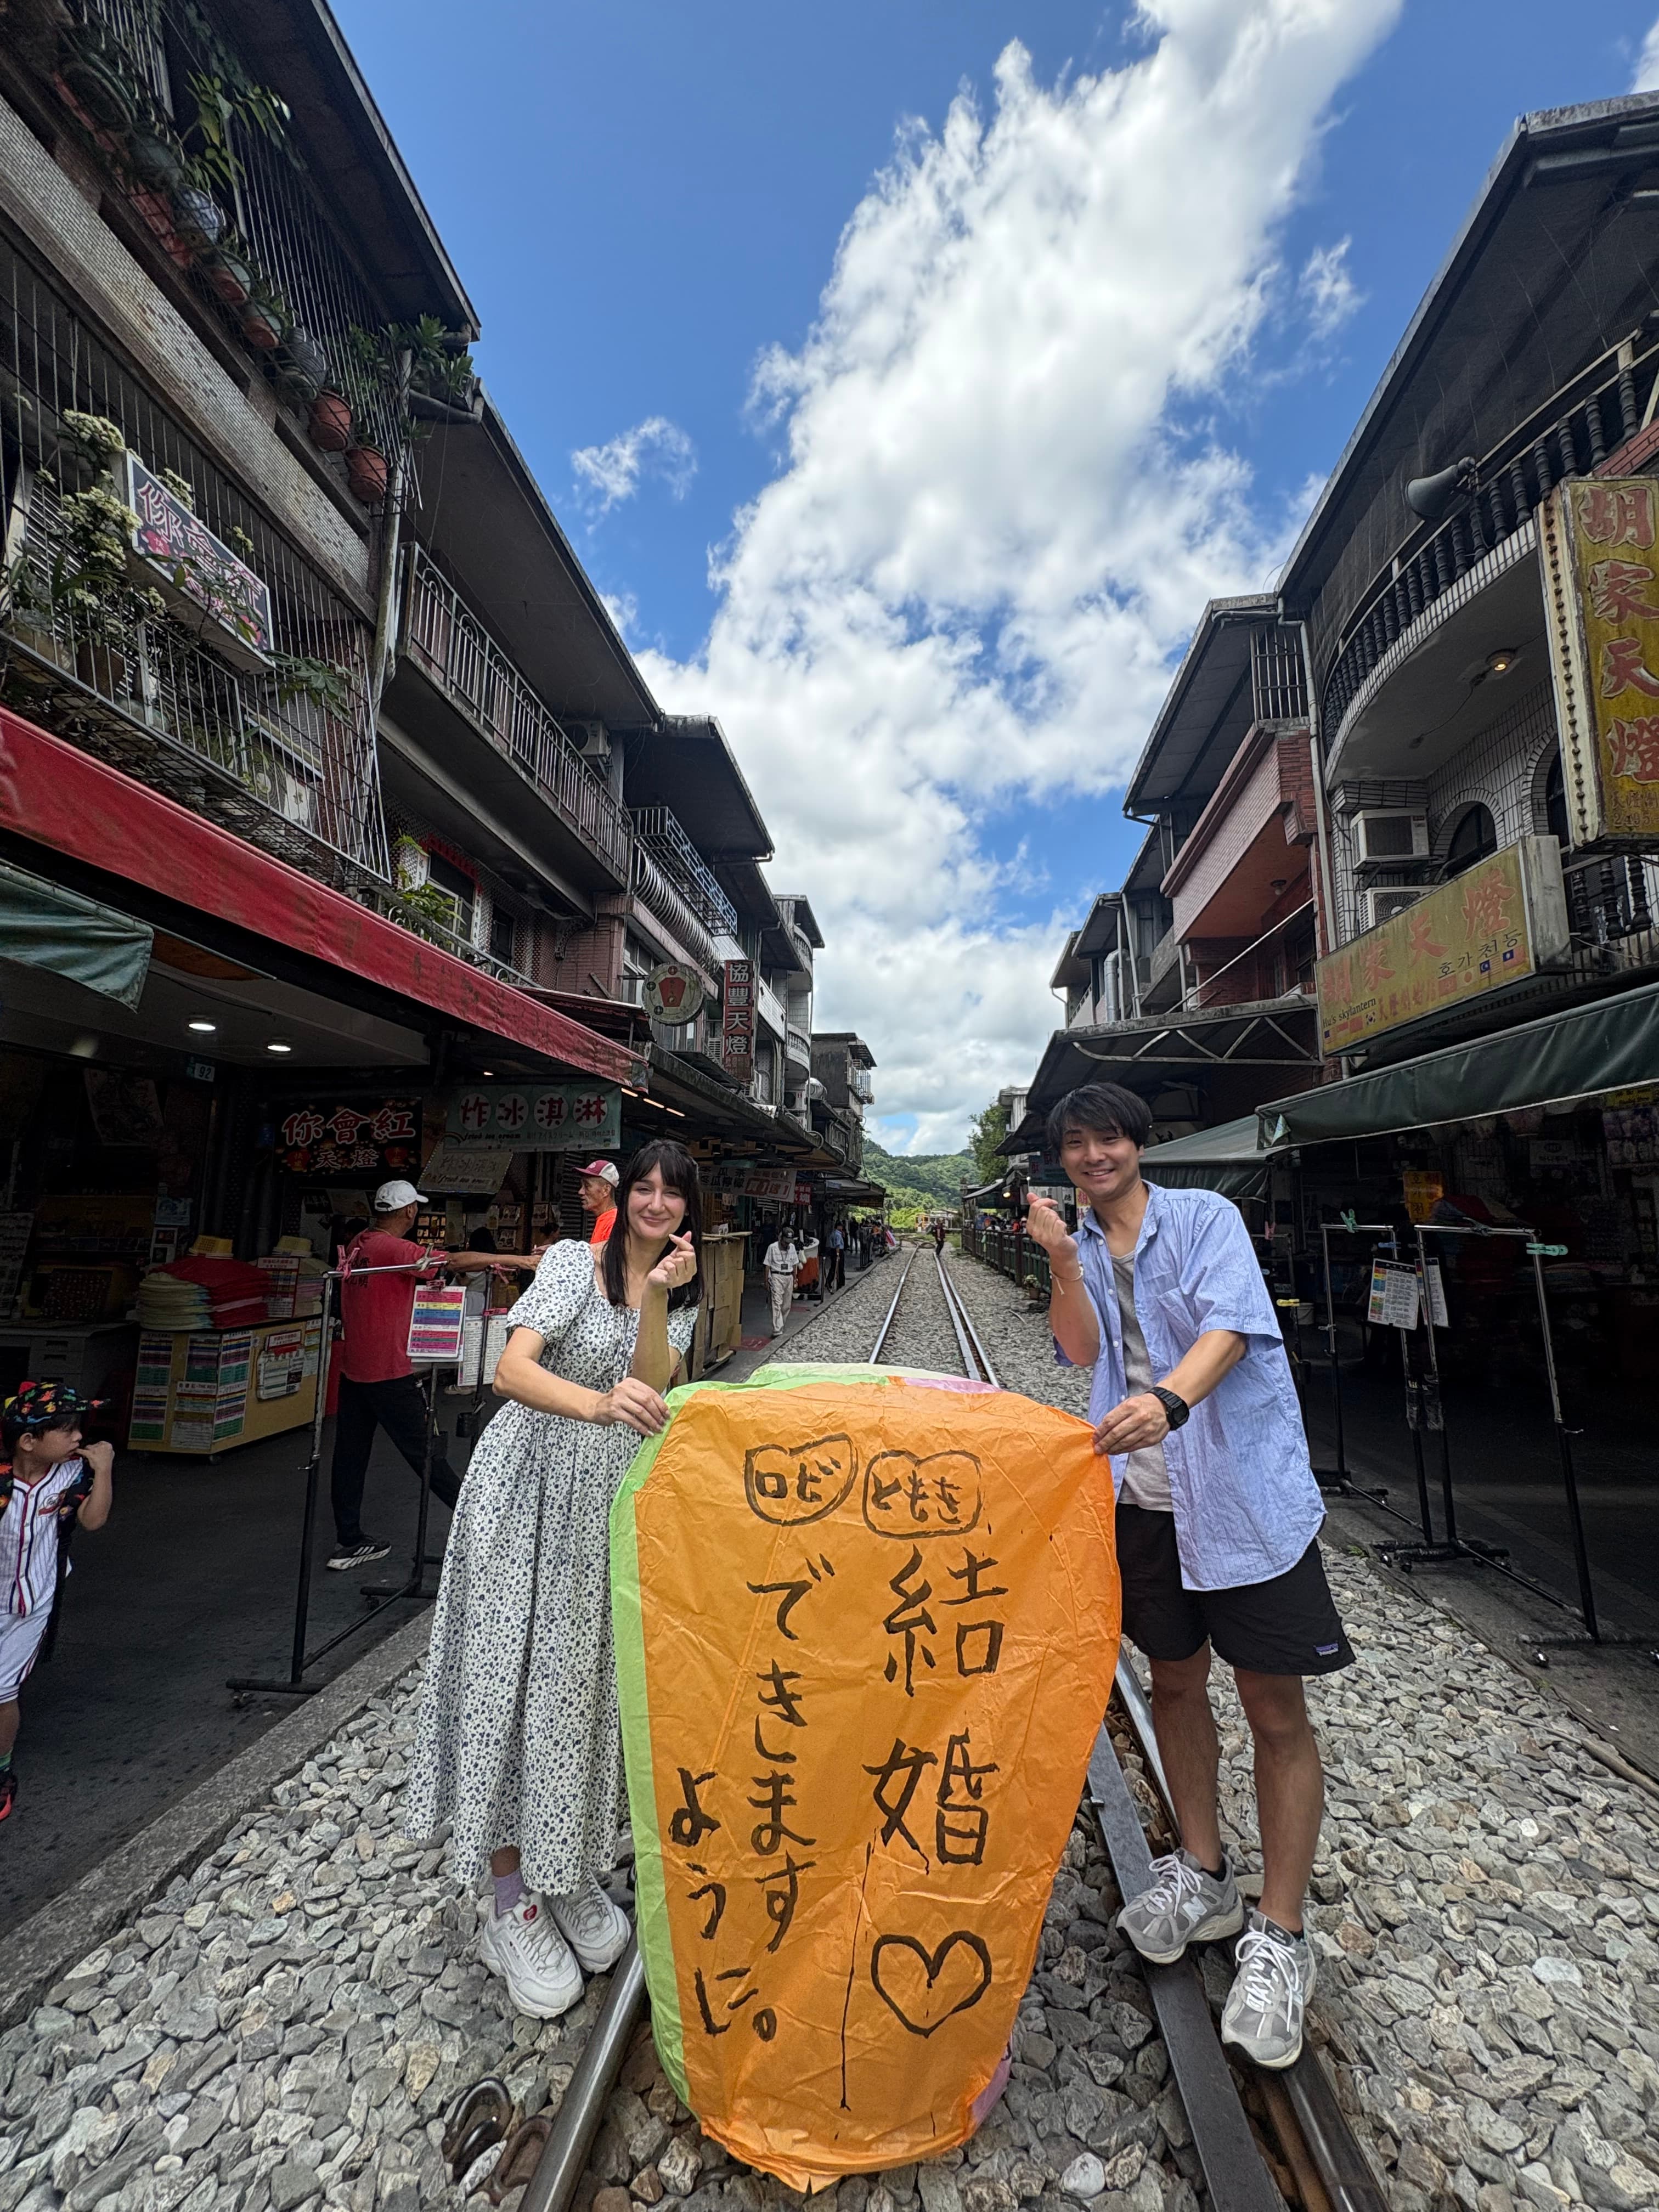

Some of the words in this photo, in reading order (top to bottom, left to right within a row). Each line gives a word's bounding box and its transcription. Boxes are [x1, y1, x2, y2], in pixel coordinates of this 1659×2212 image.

[1321, 867, 1518, 1006] 胡家天燈
[725, 963, 749, 1056] 協豐天燈
[1322, 1013, 1337, 1028] Hu's
[1338, 998, 1377, 1020] skylantern
[199, 1066, 211, 1079] 92
[281, 1107, 416, 1146] 你會紅
[461, 1094, 607, 1127] 炸冰淇淋
[315, 1149, 380, 1170] 天燈
[862, 1544, 1009, 1874] 結婚
[745, 1552, 835, 1955] できます
